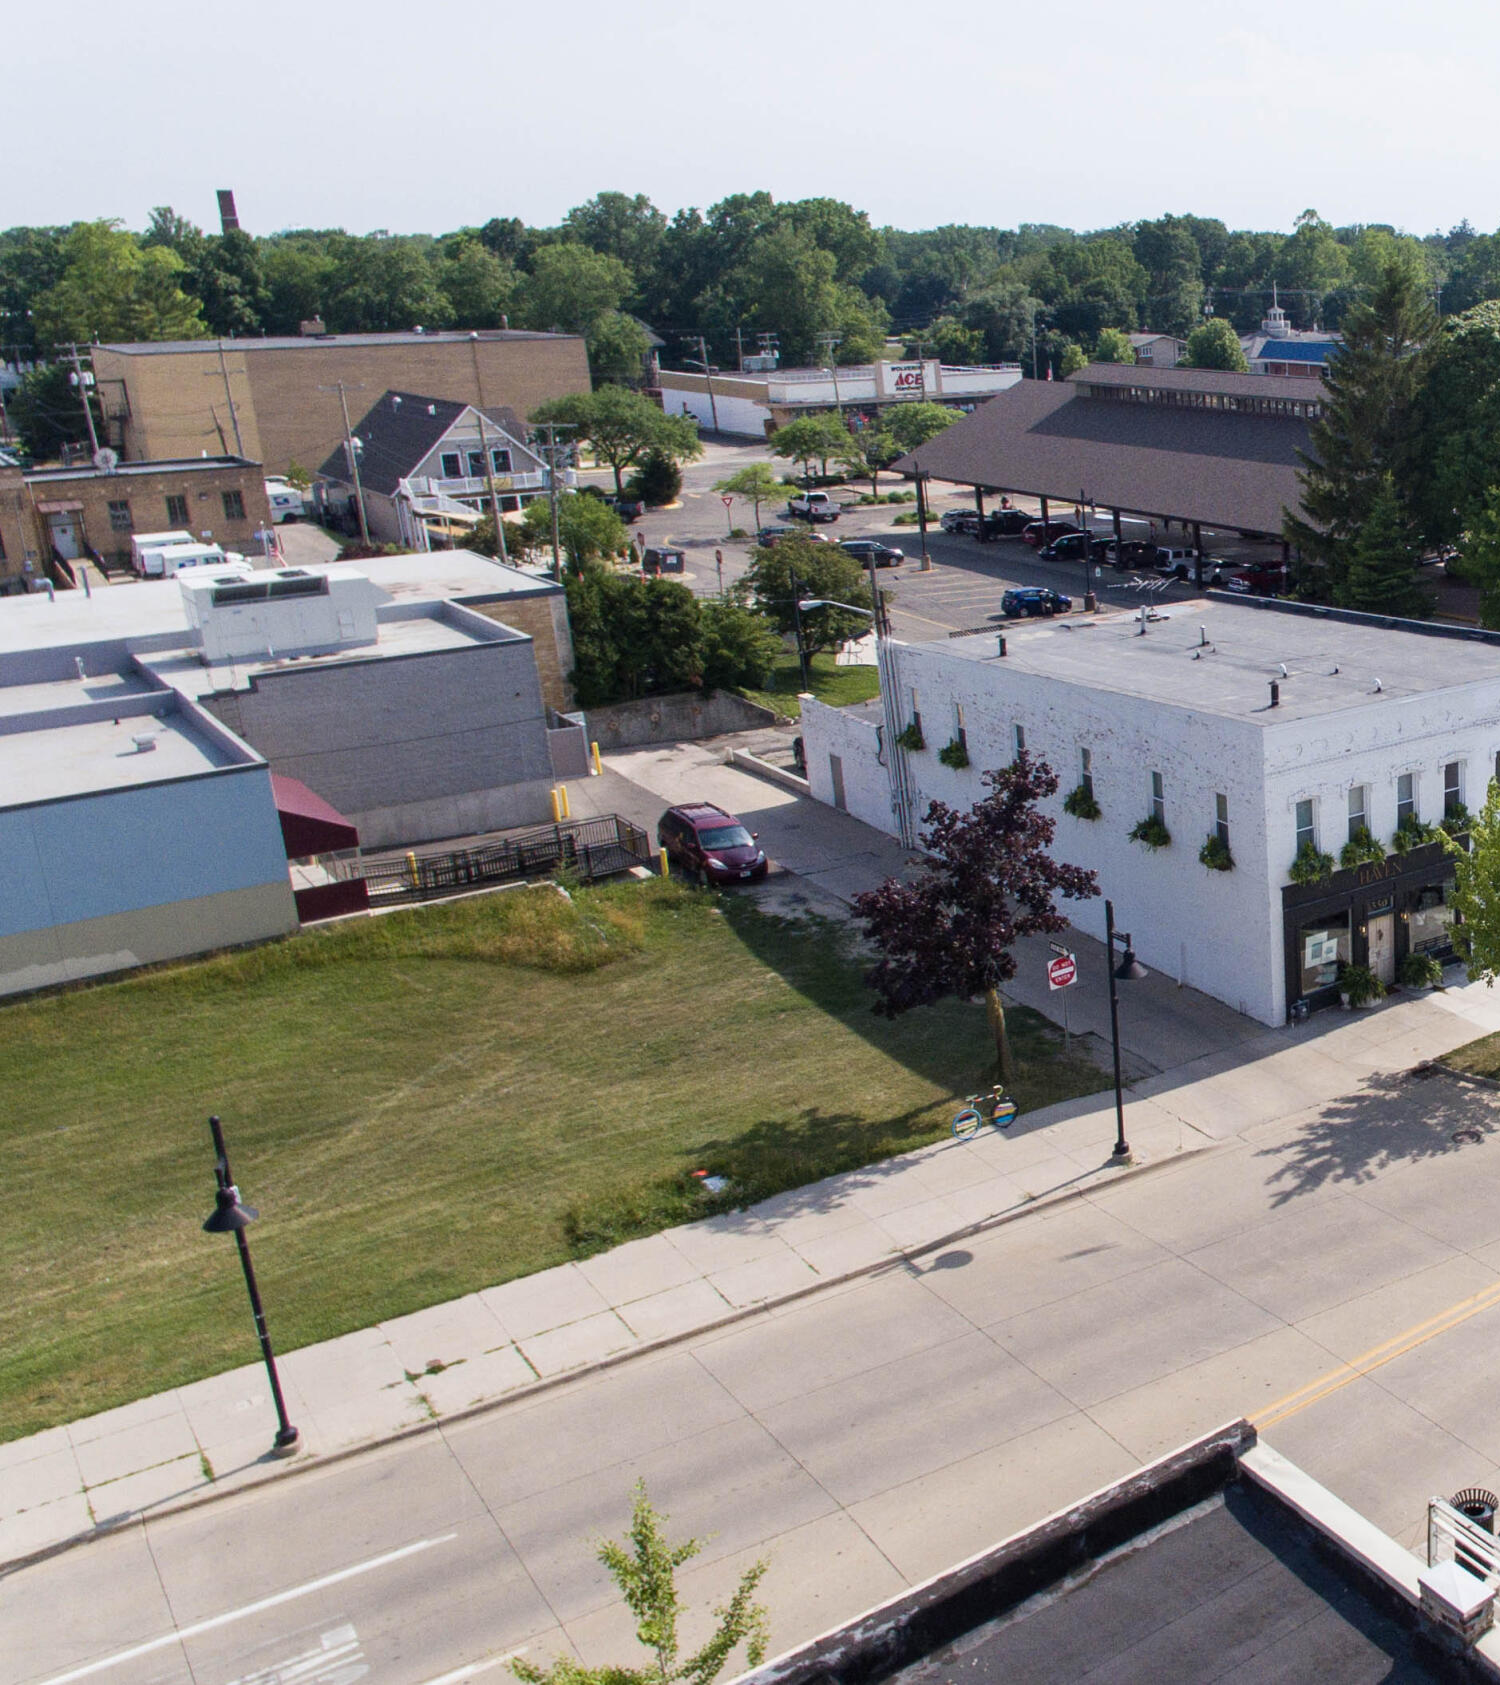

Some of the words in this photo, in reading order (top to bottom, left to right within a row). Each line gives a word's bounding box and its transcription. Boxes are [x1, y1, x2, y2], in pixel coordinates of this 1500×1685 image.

[895, 372, 924, 386] ACE
[1360, 861, 1402, 884] HAVEN
[1055, 973, 1070, 983] ENTER
